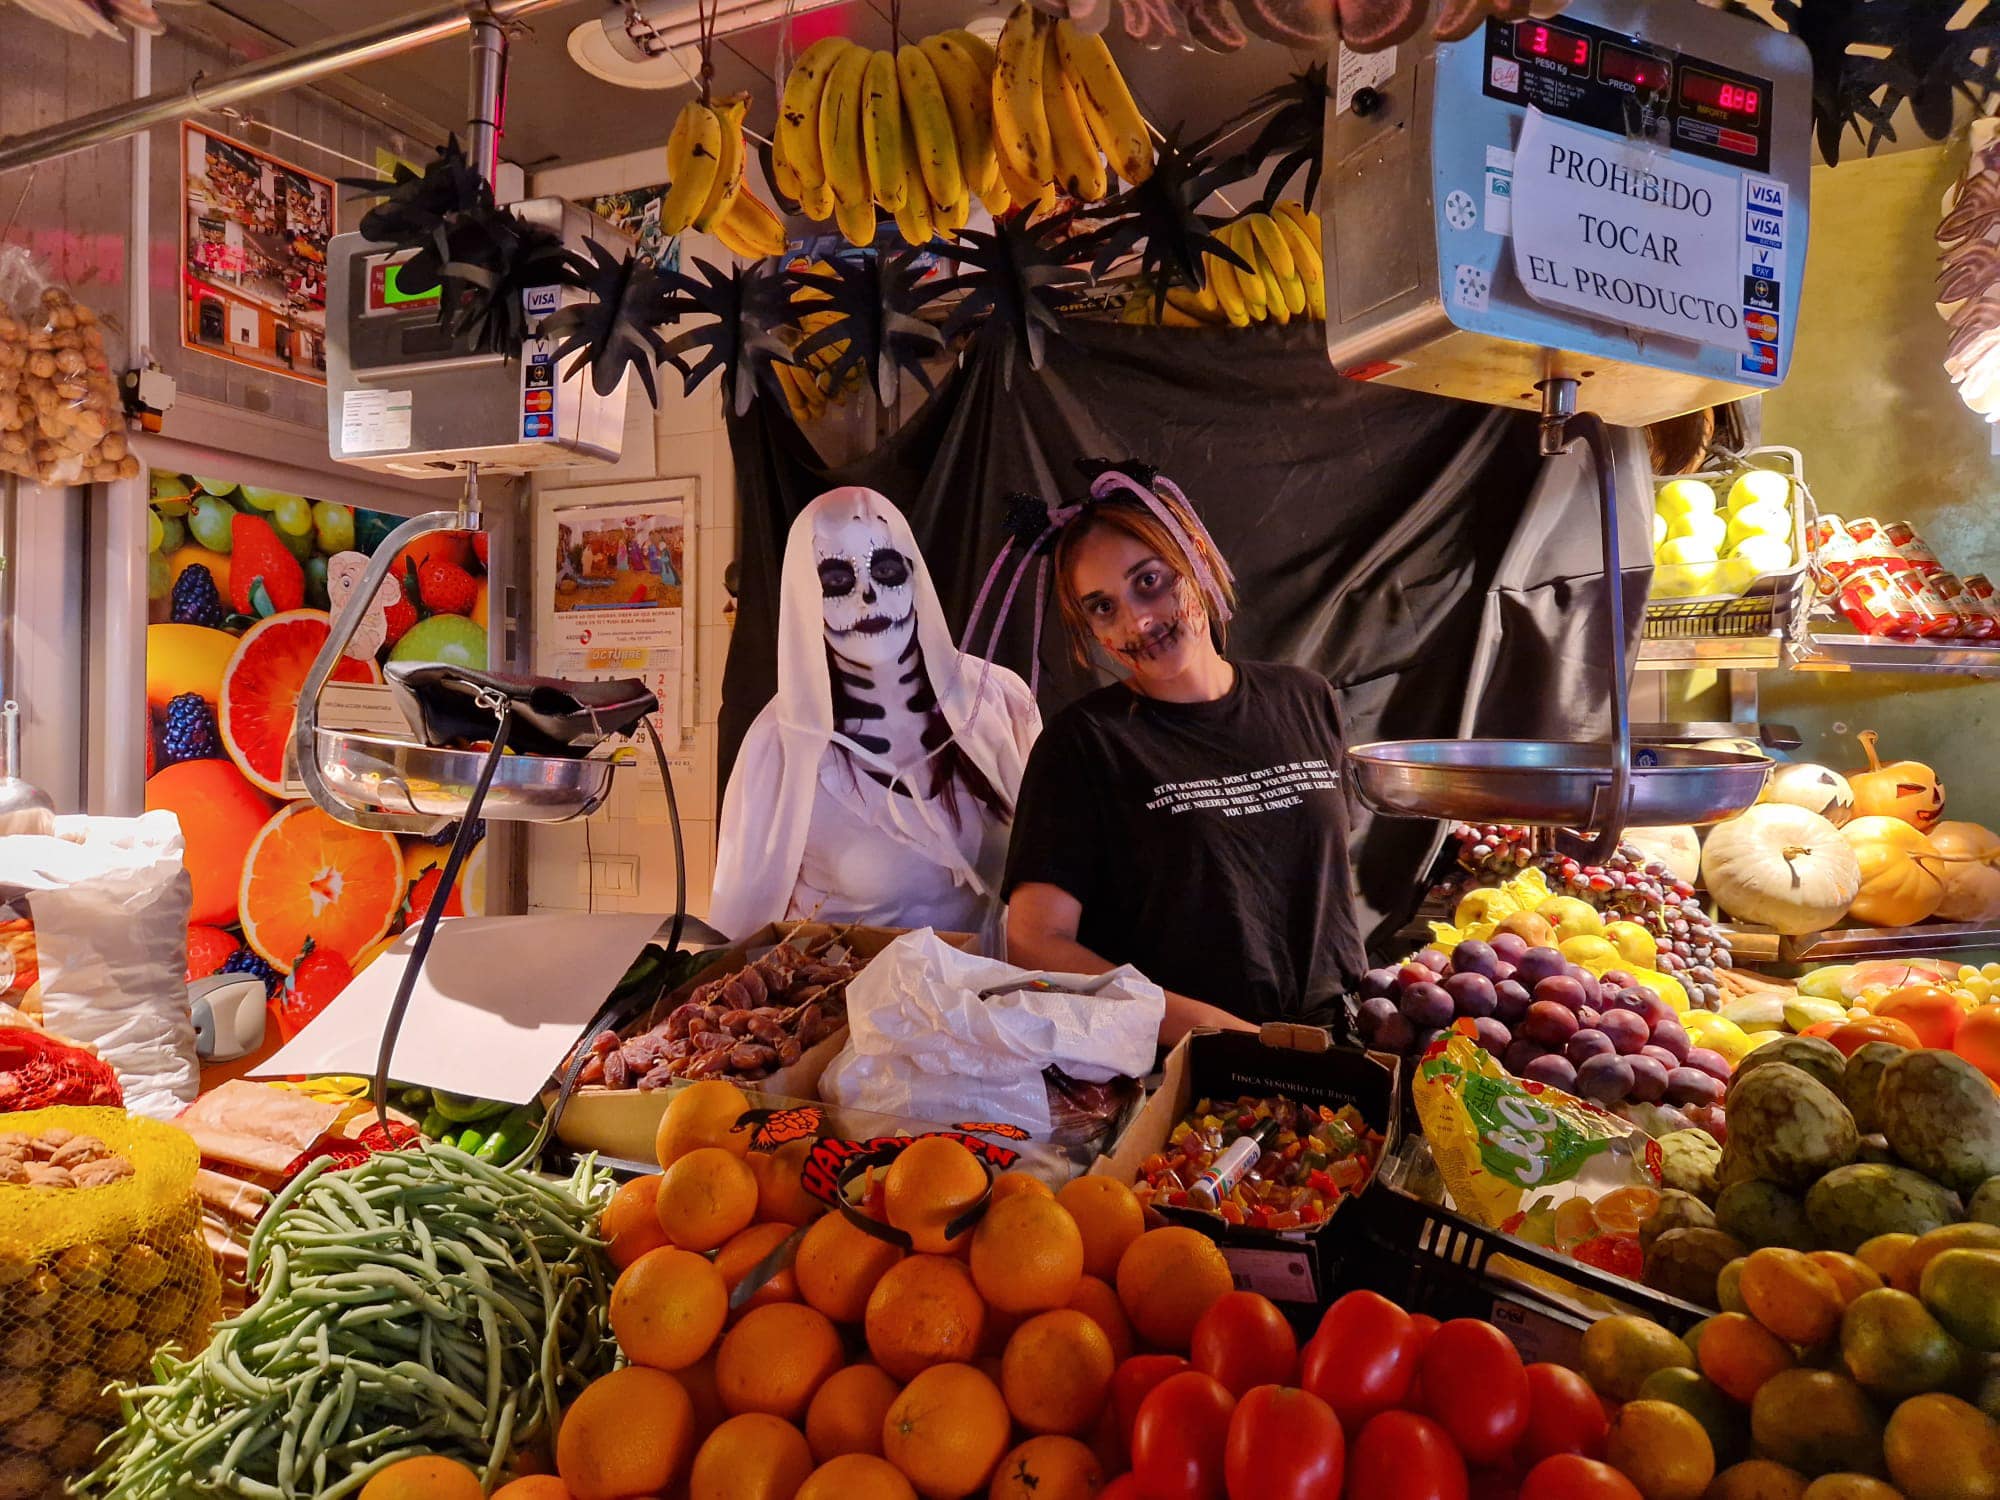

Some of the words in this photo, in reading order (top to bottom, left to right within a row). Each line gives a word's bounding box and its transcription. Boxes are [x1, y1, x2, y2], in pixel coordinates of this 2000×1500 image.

[1535, 57, 1557, 71] PESO
[1557, 64, 1568, 77] Kg
[1608, 78, 1637, 94] PRECIO
[1548, 143, 1713, 218] PROHIBIDO
[1752, 185, 1782, 205] VISA
[1751, 217, 1781, 237] VISA
[1577, 212, 1683, 268] TOCAR
[1759, 249, 1768, 264] V
[532, 293, 555, 306] VISA
[1527, 254, 1569, 289] EL
[1573, 266, 1739, 330] PRODUCTO
[658, 674, 665, 684] 2
[636, 733, 646, 744] 29
[1145, 795, 1174, 811] WITH
[1224, 782, 1261, 797] REMIND
[1261, 771, 1308, 788] YOURSELF
[1154, 783, 1177, 797] STAY
[1222, 774, 1249, 786] DONT
[1250, 768, 1274, 780] GIVE
[1171, 802, 1193, 815] ARE
[1192, 798, 1230, 809] NEEDED
[1259, 784, 1295, 801] YOURE
[1294, 782, 1314, 792] THE
[1222, 807, 1243, 818] YOU
[1244, 803, 1265, 815] ARE
[1231, 1072, 1261, 1085] FINCA
